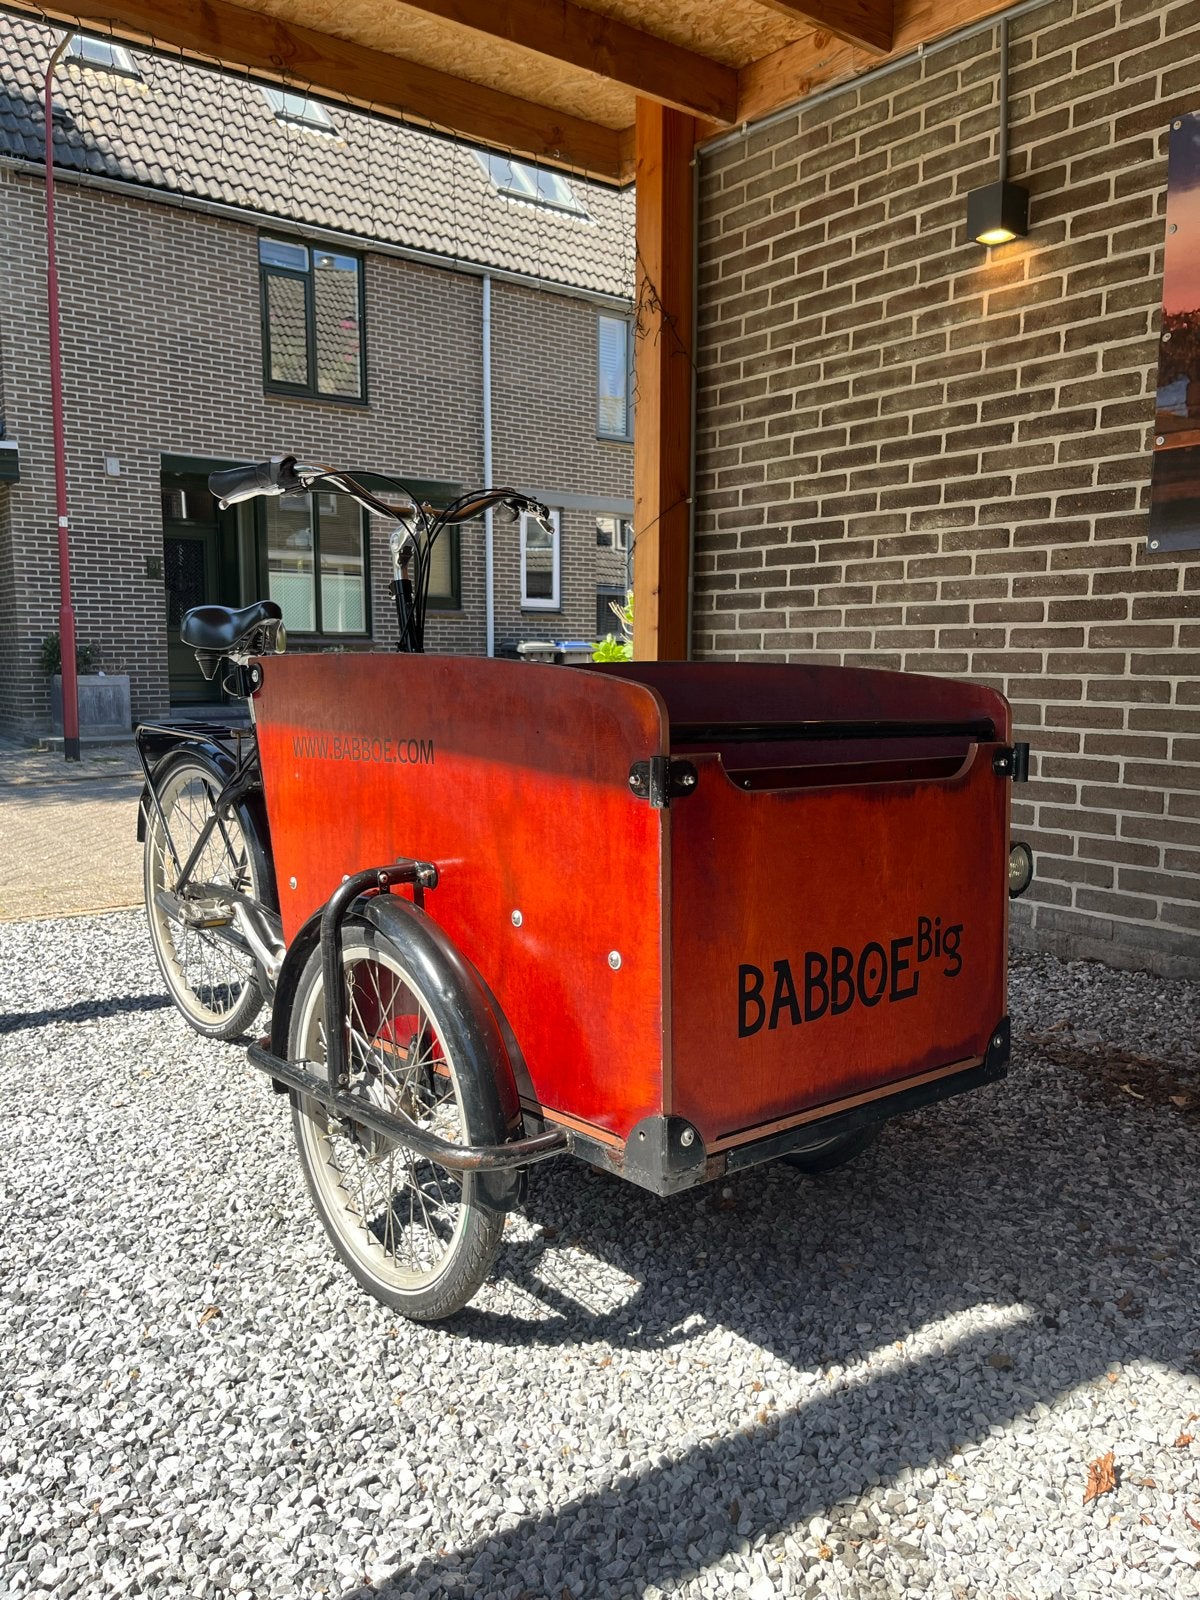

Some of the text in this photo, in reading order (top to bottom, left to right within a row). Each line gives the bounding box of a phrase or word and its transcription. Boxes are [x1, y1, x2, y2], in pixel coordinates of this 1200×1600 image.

[292, 736, 435, 765] WWW.BABBOE.COM
[738, 916, 964, 1038] BABBOE Big
